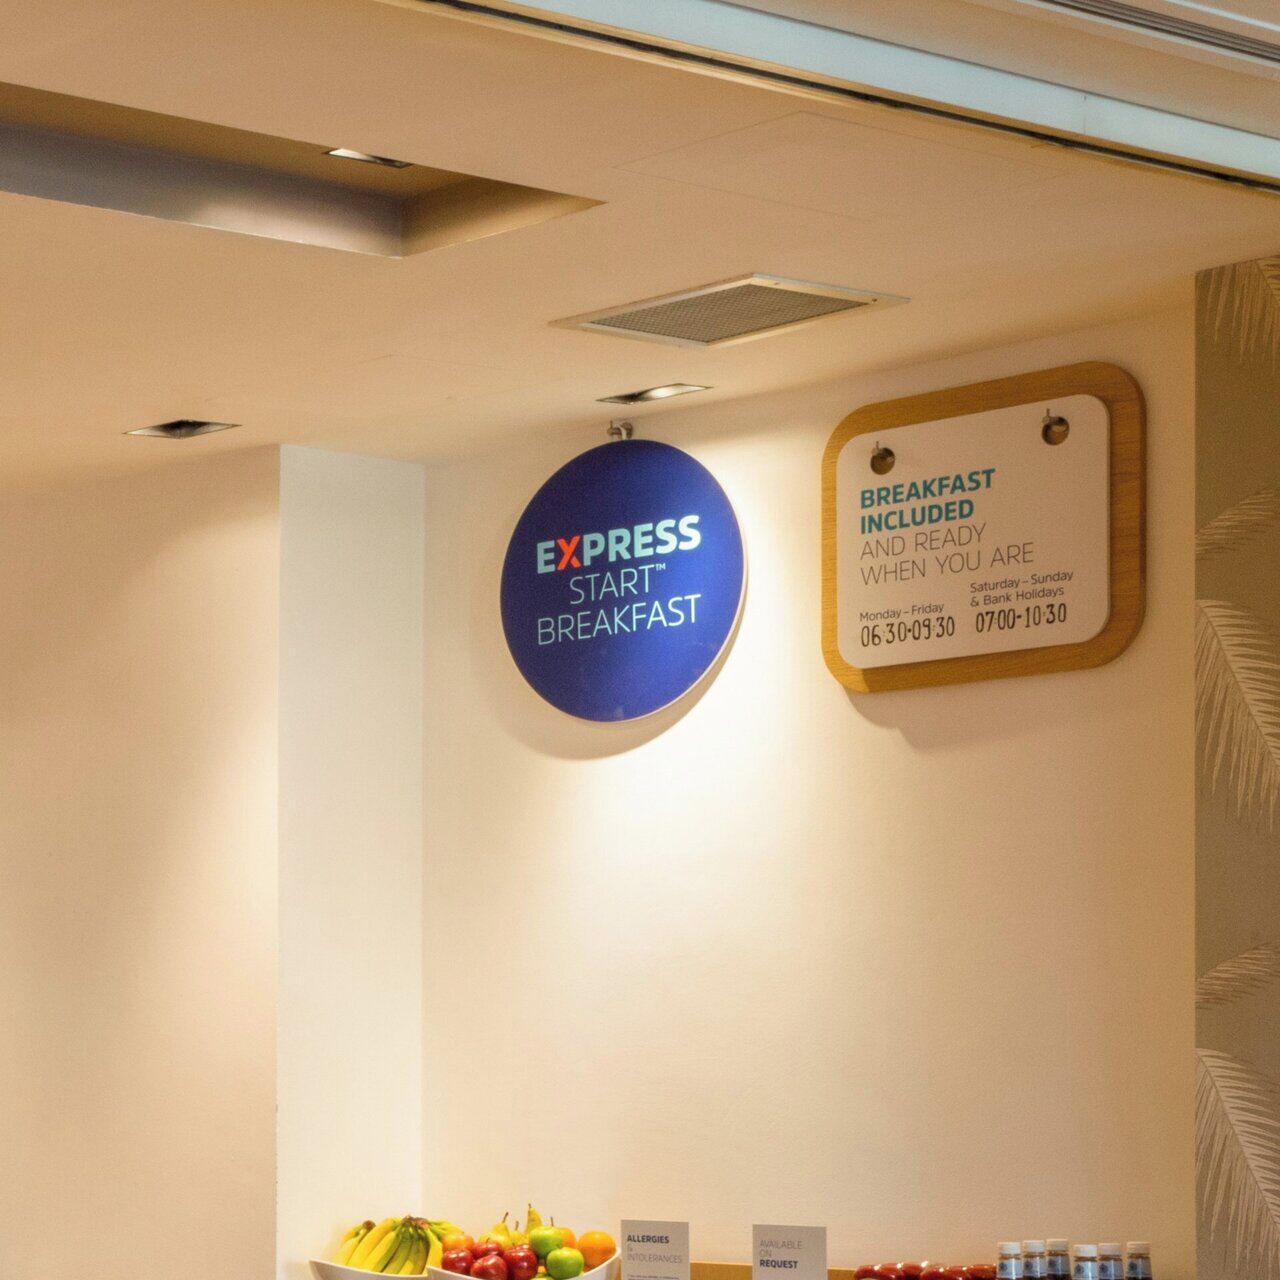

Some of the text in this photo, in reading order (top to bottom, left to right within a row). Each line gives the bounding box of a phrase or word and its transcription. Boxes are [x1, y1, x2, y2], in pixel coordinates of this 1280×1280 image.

[860, 469, 996, 509] BREAKFAST
[860, 499, 974, 534] INCLUDED
[537, 514, 702, 575] EXPRESS
[860, 522, 987, 561] AND READY
[860, 541, 1035, 586] WHEN YOU ARE
[970, 578, 1021, 593] Saturday
[1030, 571, 1074, 585] Sunday
[970, 586, 1065, 607] & Bank Holidays
[538, 594, 701, 645] BREAKFAST
[860, 609, 902, 622] Monday
[911, 603, 944, 616] Friday
[627, 1234, 670, 1244] ALLERGIES
[760, 1240, 803, 1250] AVAILABLE
[627, 1253, 682, 1263] INTOLERANCES
[759, 1259, 799, 1269] REQUEST
